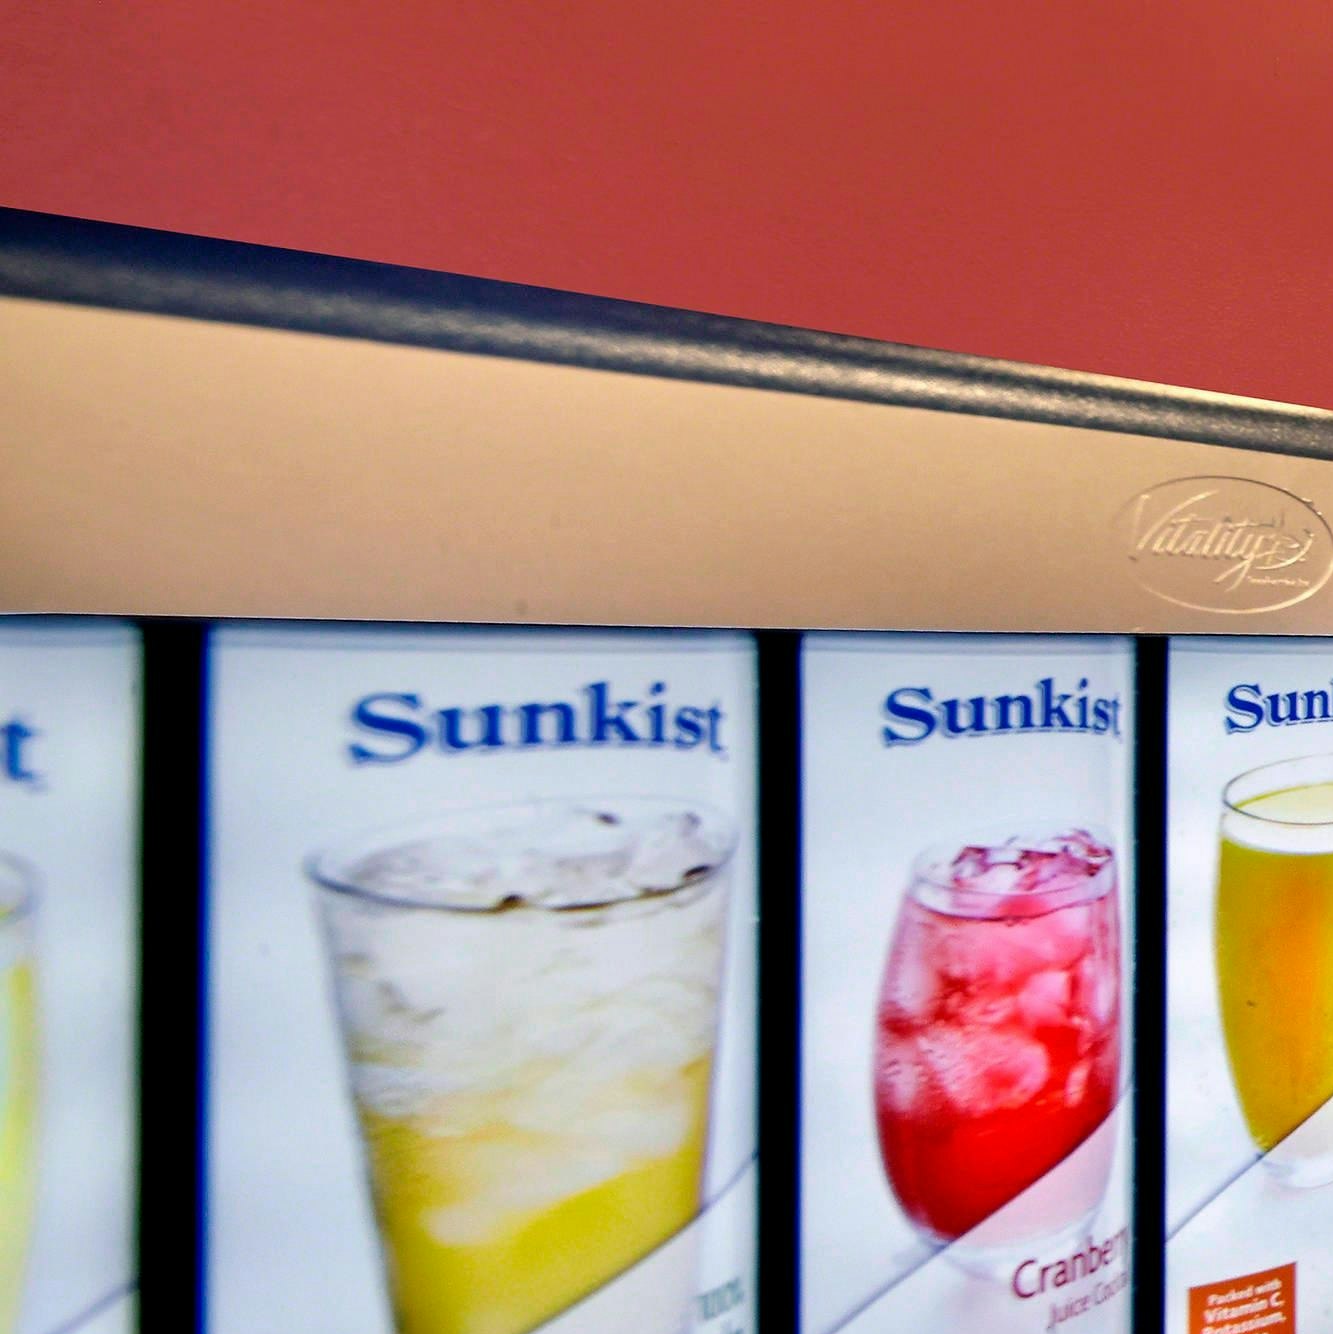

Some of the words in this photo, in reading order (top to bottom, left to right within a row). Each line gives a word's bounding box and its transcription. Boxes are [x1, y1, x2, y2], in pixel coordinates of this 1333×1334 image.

[346, 681, 727, 765] Sunkist
[884, 677, 1121, 747] Sunkist
[1203, 1296, 1270, 1325] Vitamin
